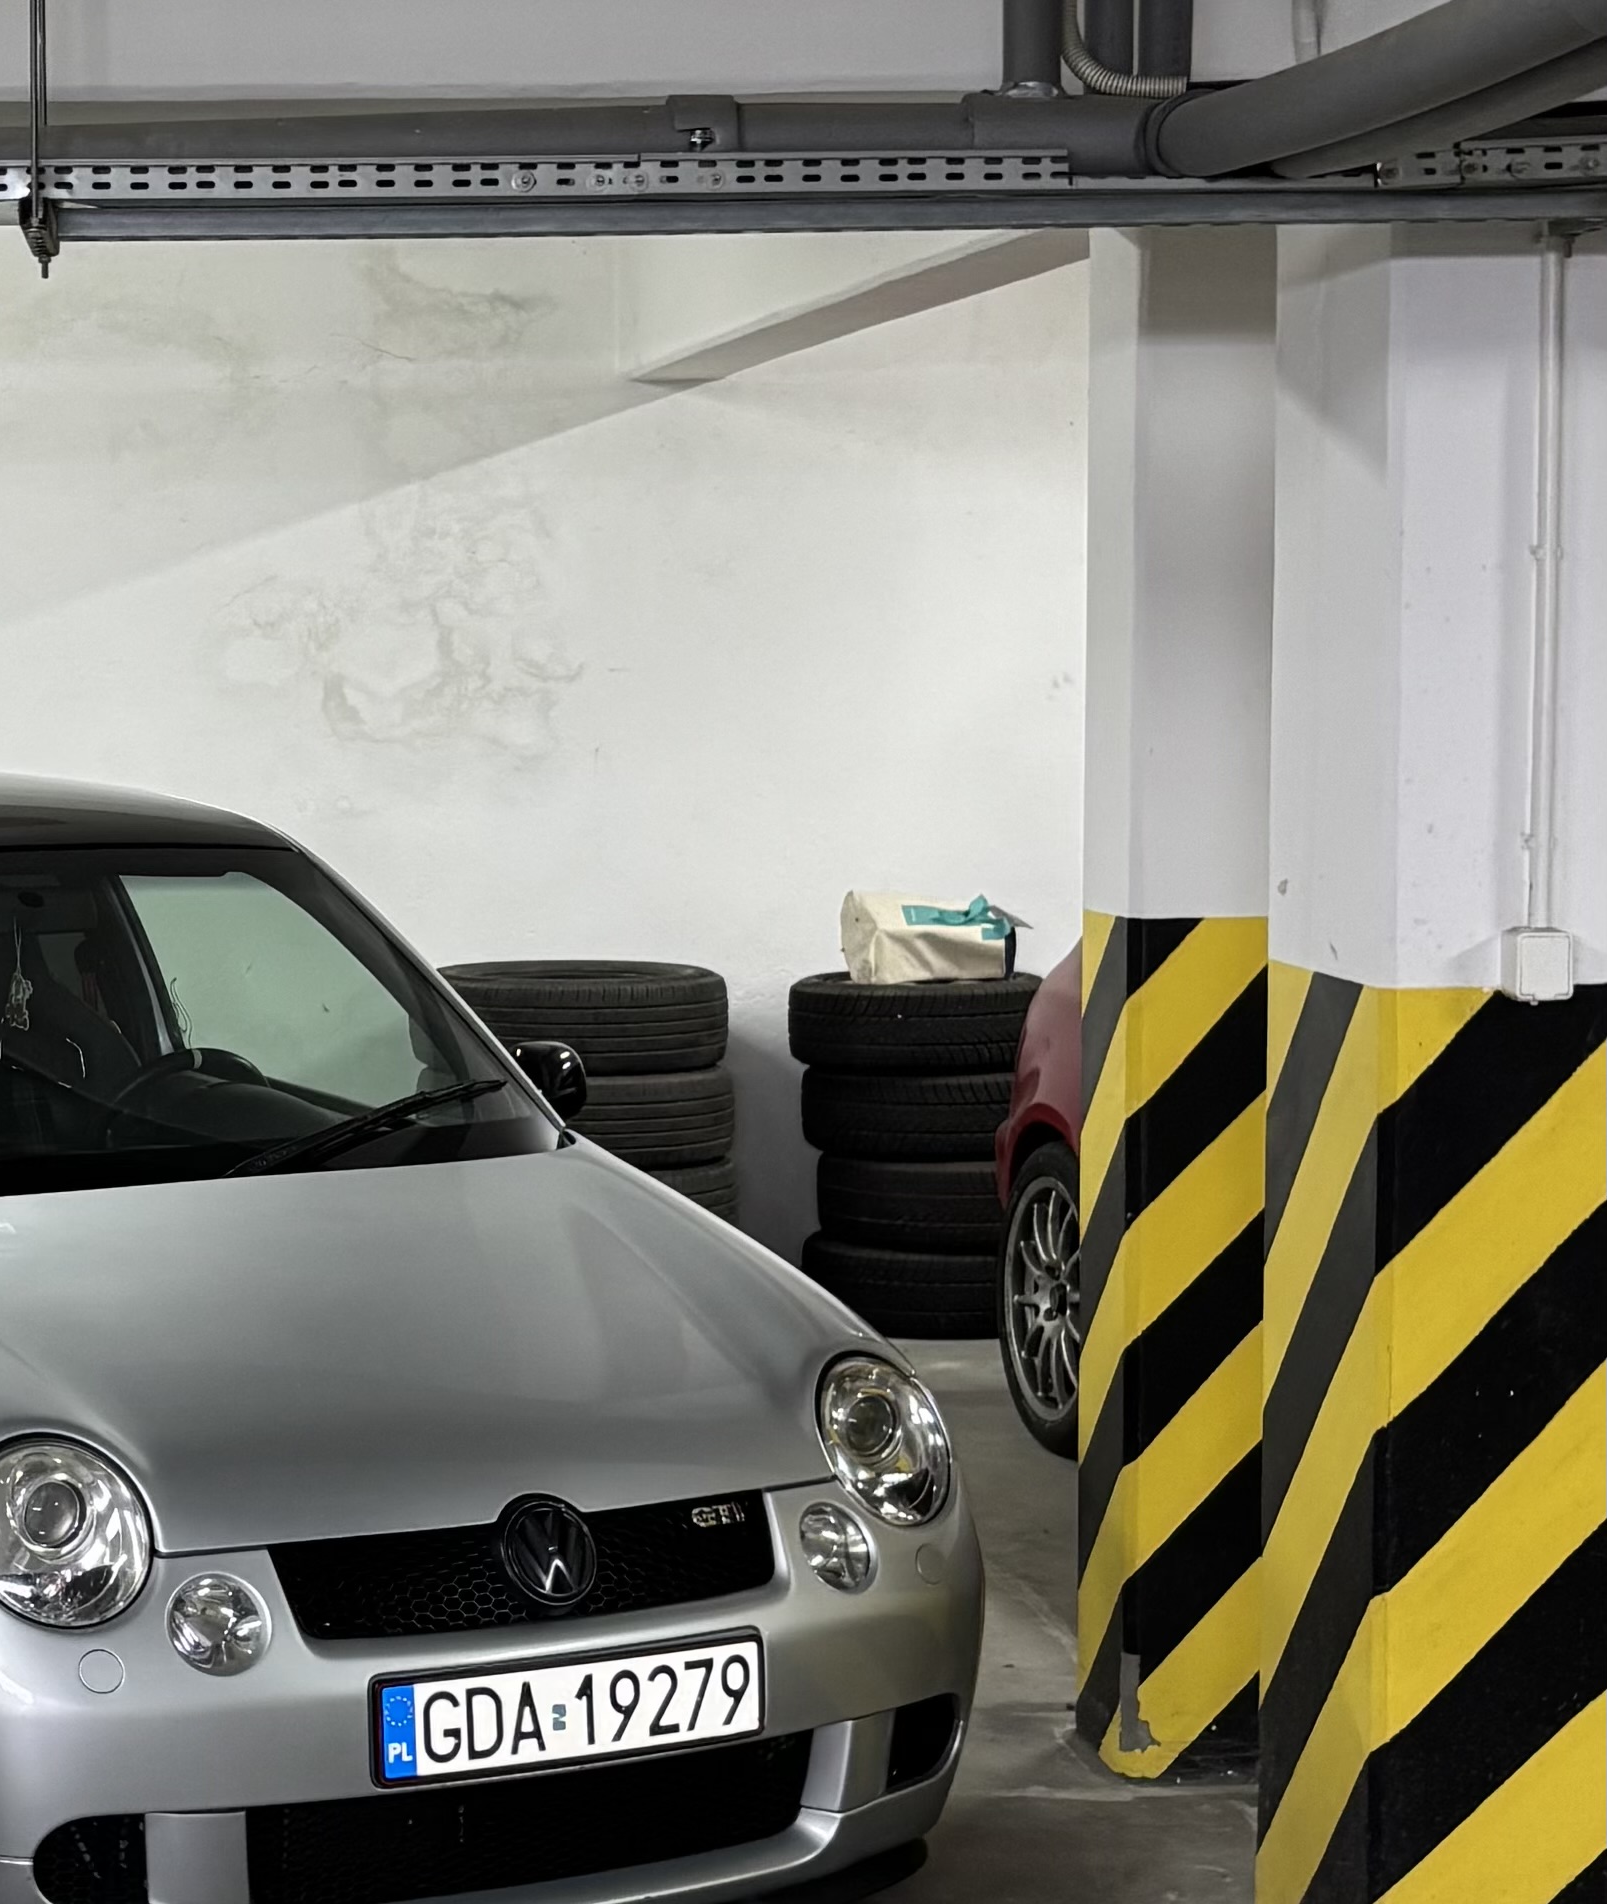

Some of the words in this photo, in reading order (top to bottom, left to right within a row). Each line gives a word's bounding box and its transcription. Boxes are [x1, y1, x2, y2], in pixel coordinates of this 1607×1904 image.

[423, 1682, 546, 1764] GDA
[575, 1655, 749, 1746] 19279
[388, 1741, 413, 1764] PL
